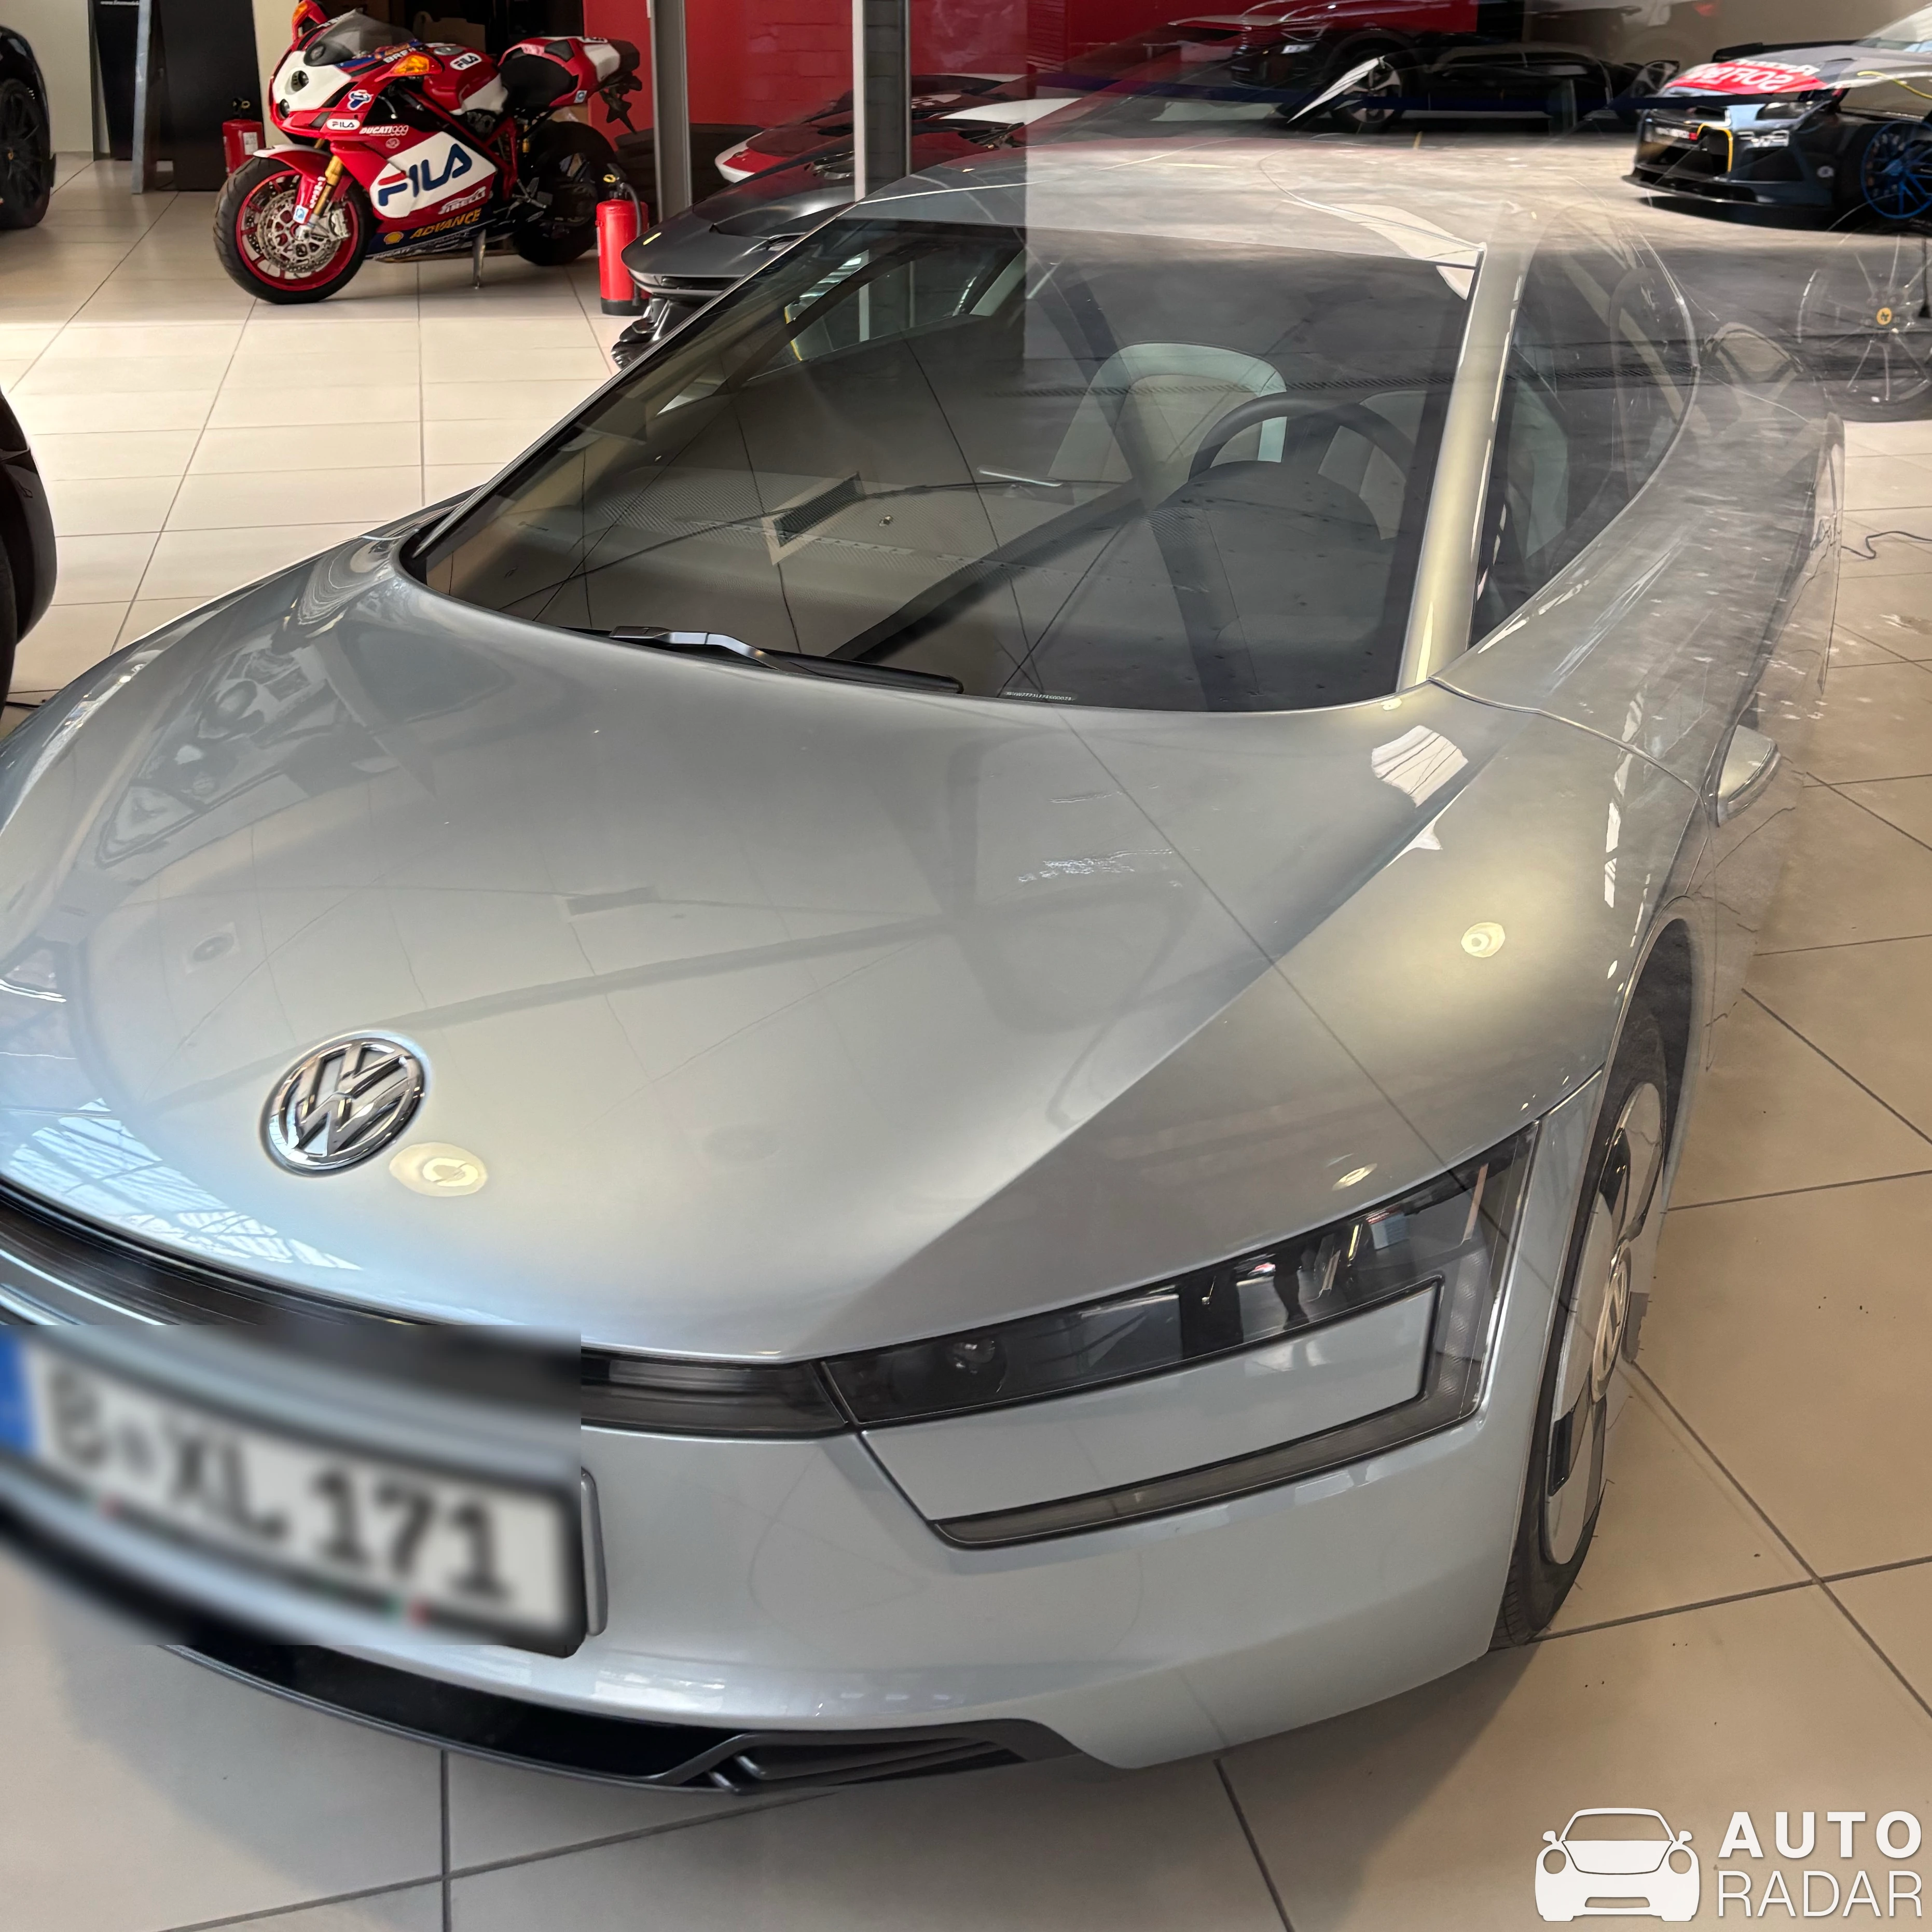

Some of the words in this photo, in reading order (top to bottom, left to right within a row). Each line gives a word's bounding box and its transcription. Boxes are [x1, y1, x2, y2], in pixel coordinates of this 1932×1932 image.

[453, 55, 478, 68] FILA
[378, 144, 472, 206] FILA
[409, 208, 481, 239] ADVANCE
[310, 1467, 510, 1604] 171
